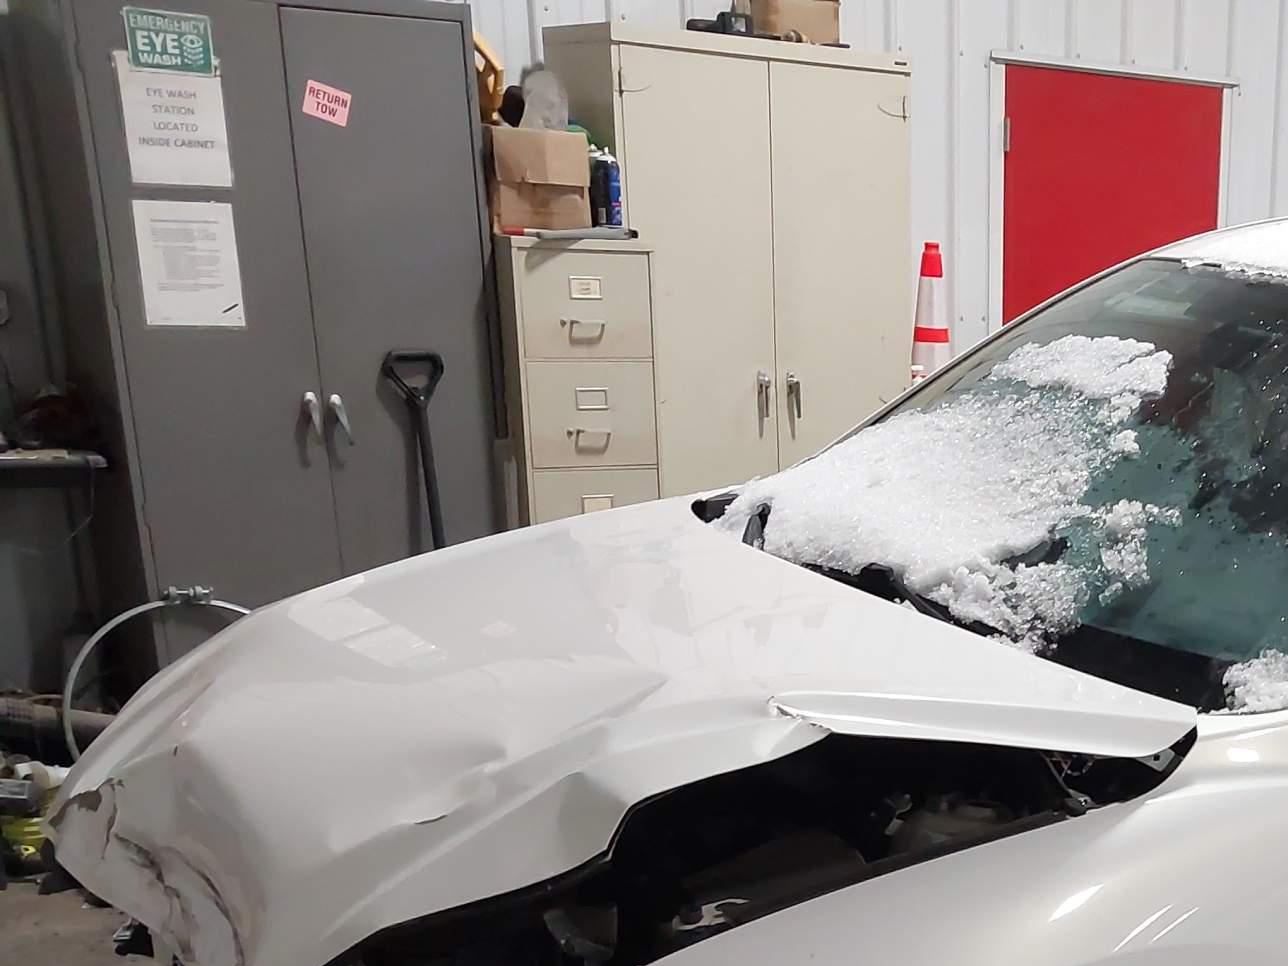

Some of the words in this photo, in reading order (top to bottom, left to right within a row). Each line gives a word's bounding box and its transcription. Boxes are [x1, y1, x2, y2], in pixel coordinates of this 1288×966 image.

[129, 13, 205, 34] EMERGENCY
[135, 29, 181, 55] EYE
[138, 52, 182, 66] WASH
[146, 87, 163, 98] EYE
[166, 89, 197, 100] WASH
[308, 86, 348, 109] RETURN
[151, 104, 195, 116] STATION
[315, 100, 338, 118] TOW
[153, 121, 199, 133] LOCATED
[138, 136, 171, 148] INSIDE
[174, 138, 216, 150] CABINET
